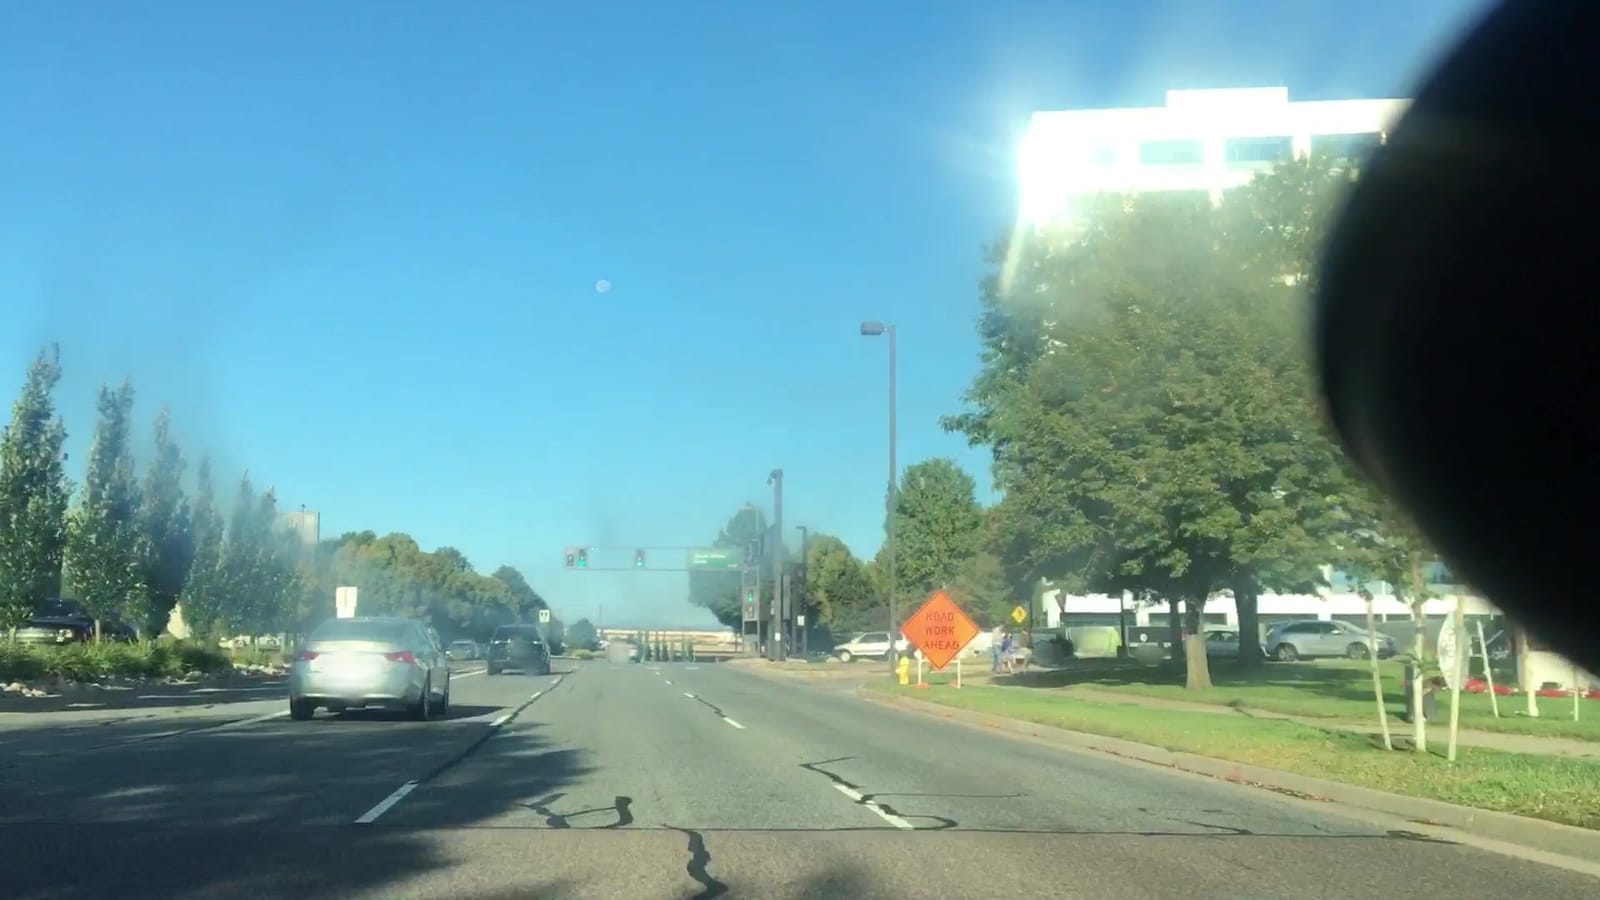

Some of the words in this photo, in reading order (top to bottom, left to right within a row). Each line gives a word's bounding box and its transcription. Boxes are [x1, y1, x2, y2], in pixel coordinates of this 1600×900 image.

[926, 612, 954, 621] ROAD
[925, 626, 955, 635] WORK
[923, 640, 960, 650] AHEAD
